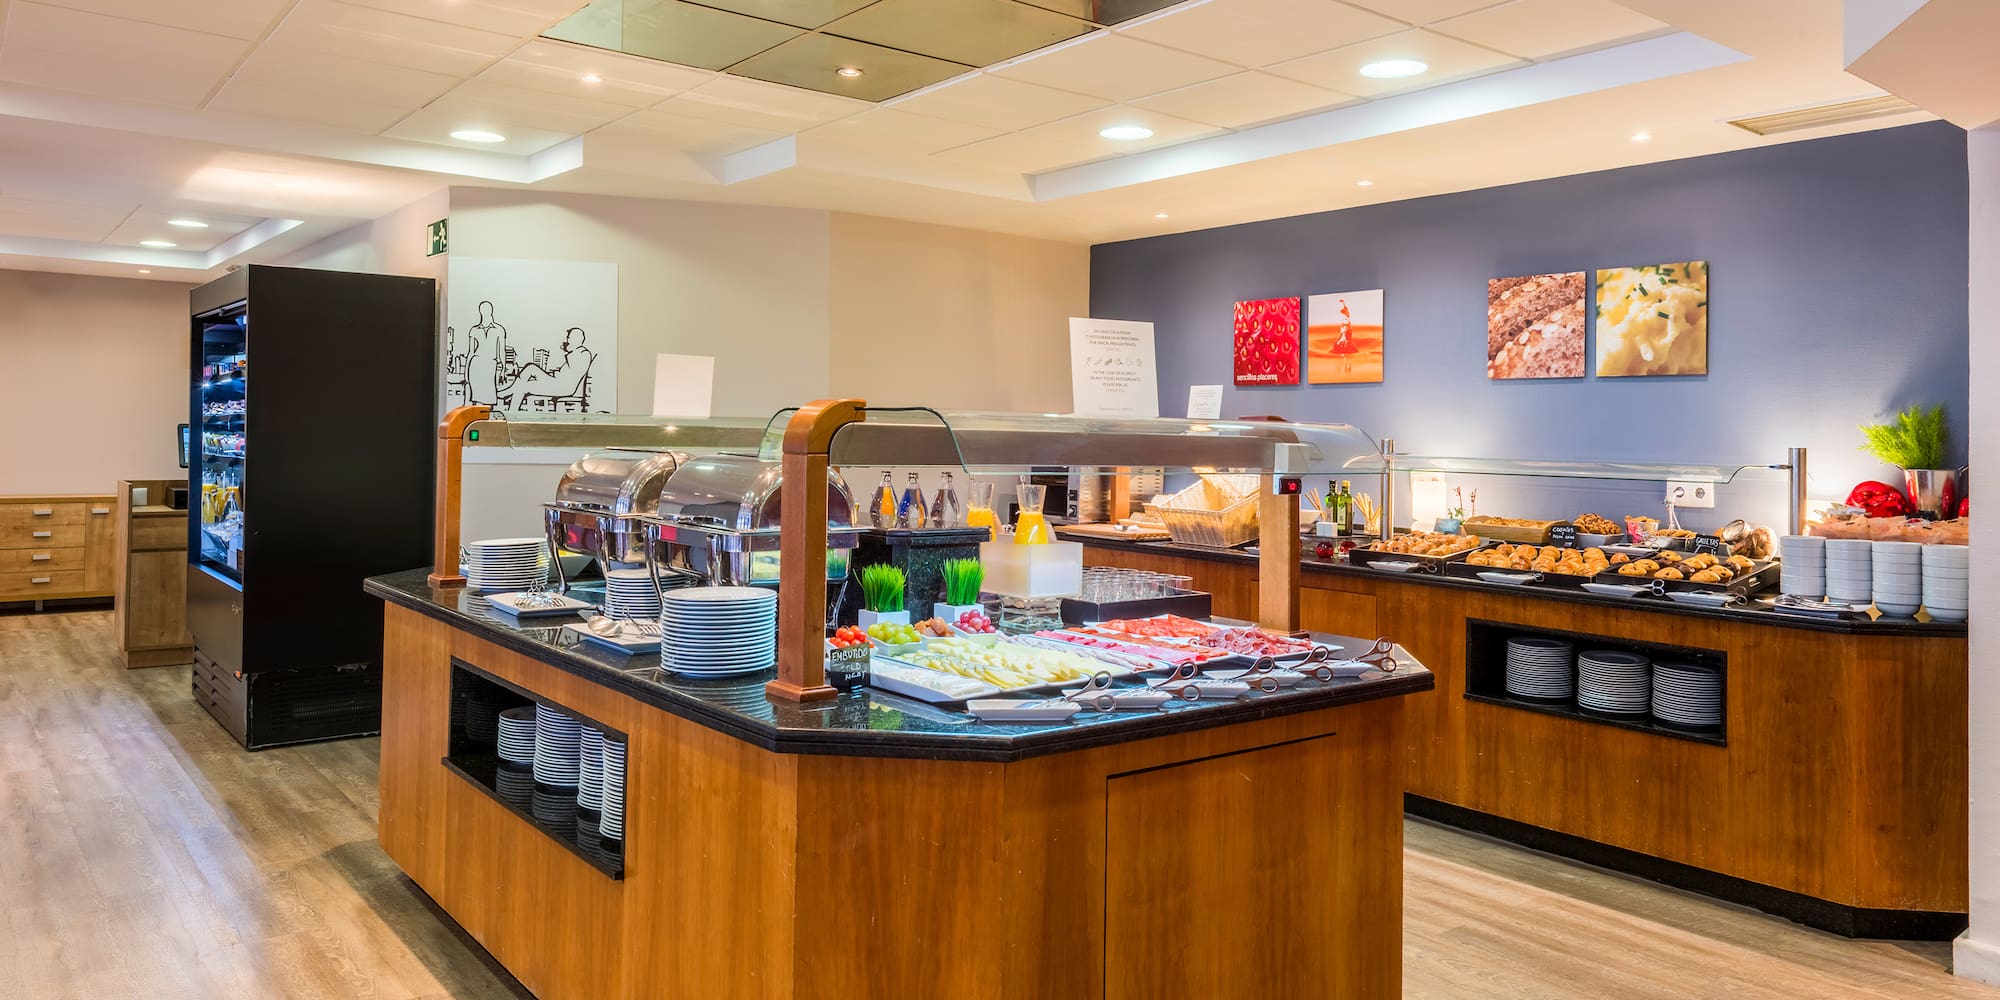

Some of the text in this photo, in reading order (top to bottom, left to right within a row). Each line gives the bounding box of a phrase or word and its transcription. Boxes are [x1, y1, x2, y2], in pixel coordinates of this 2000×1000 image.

[1237, 373, 1278, 382] sencillos placeres
[832, 647, 868, 661] EMBUTIDO
